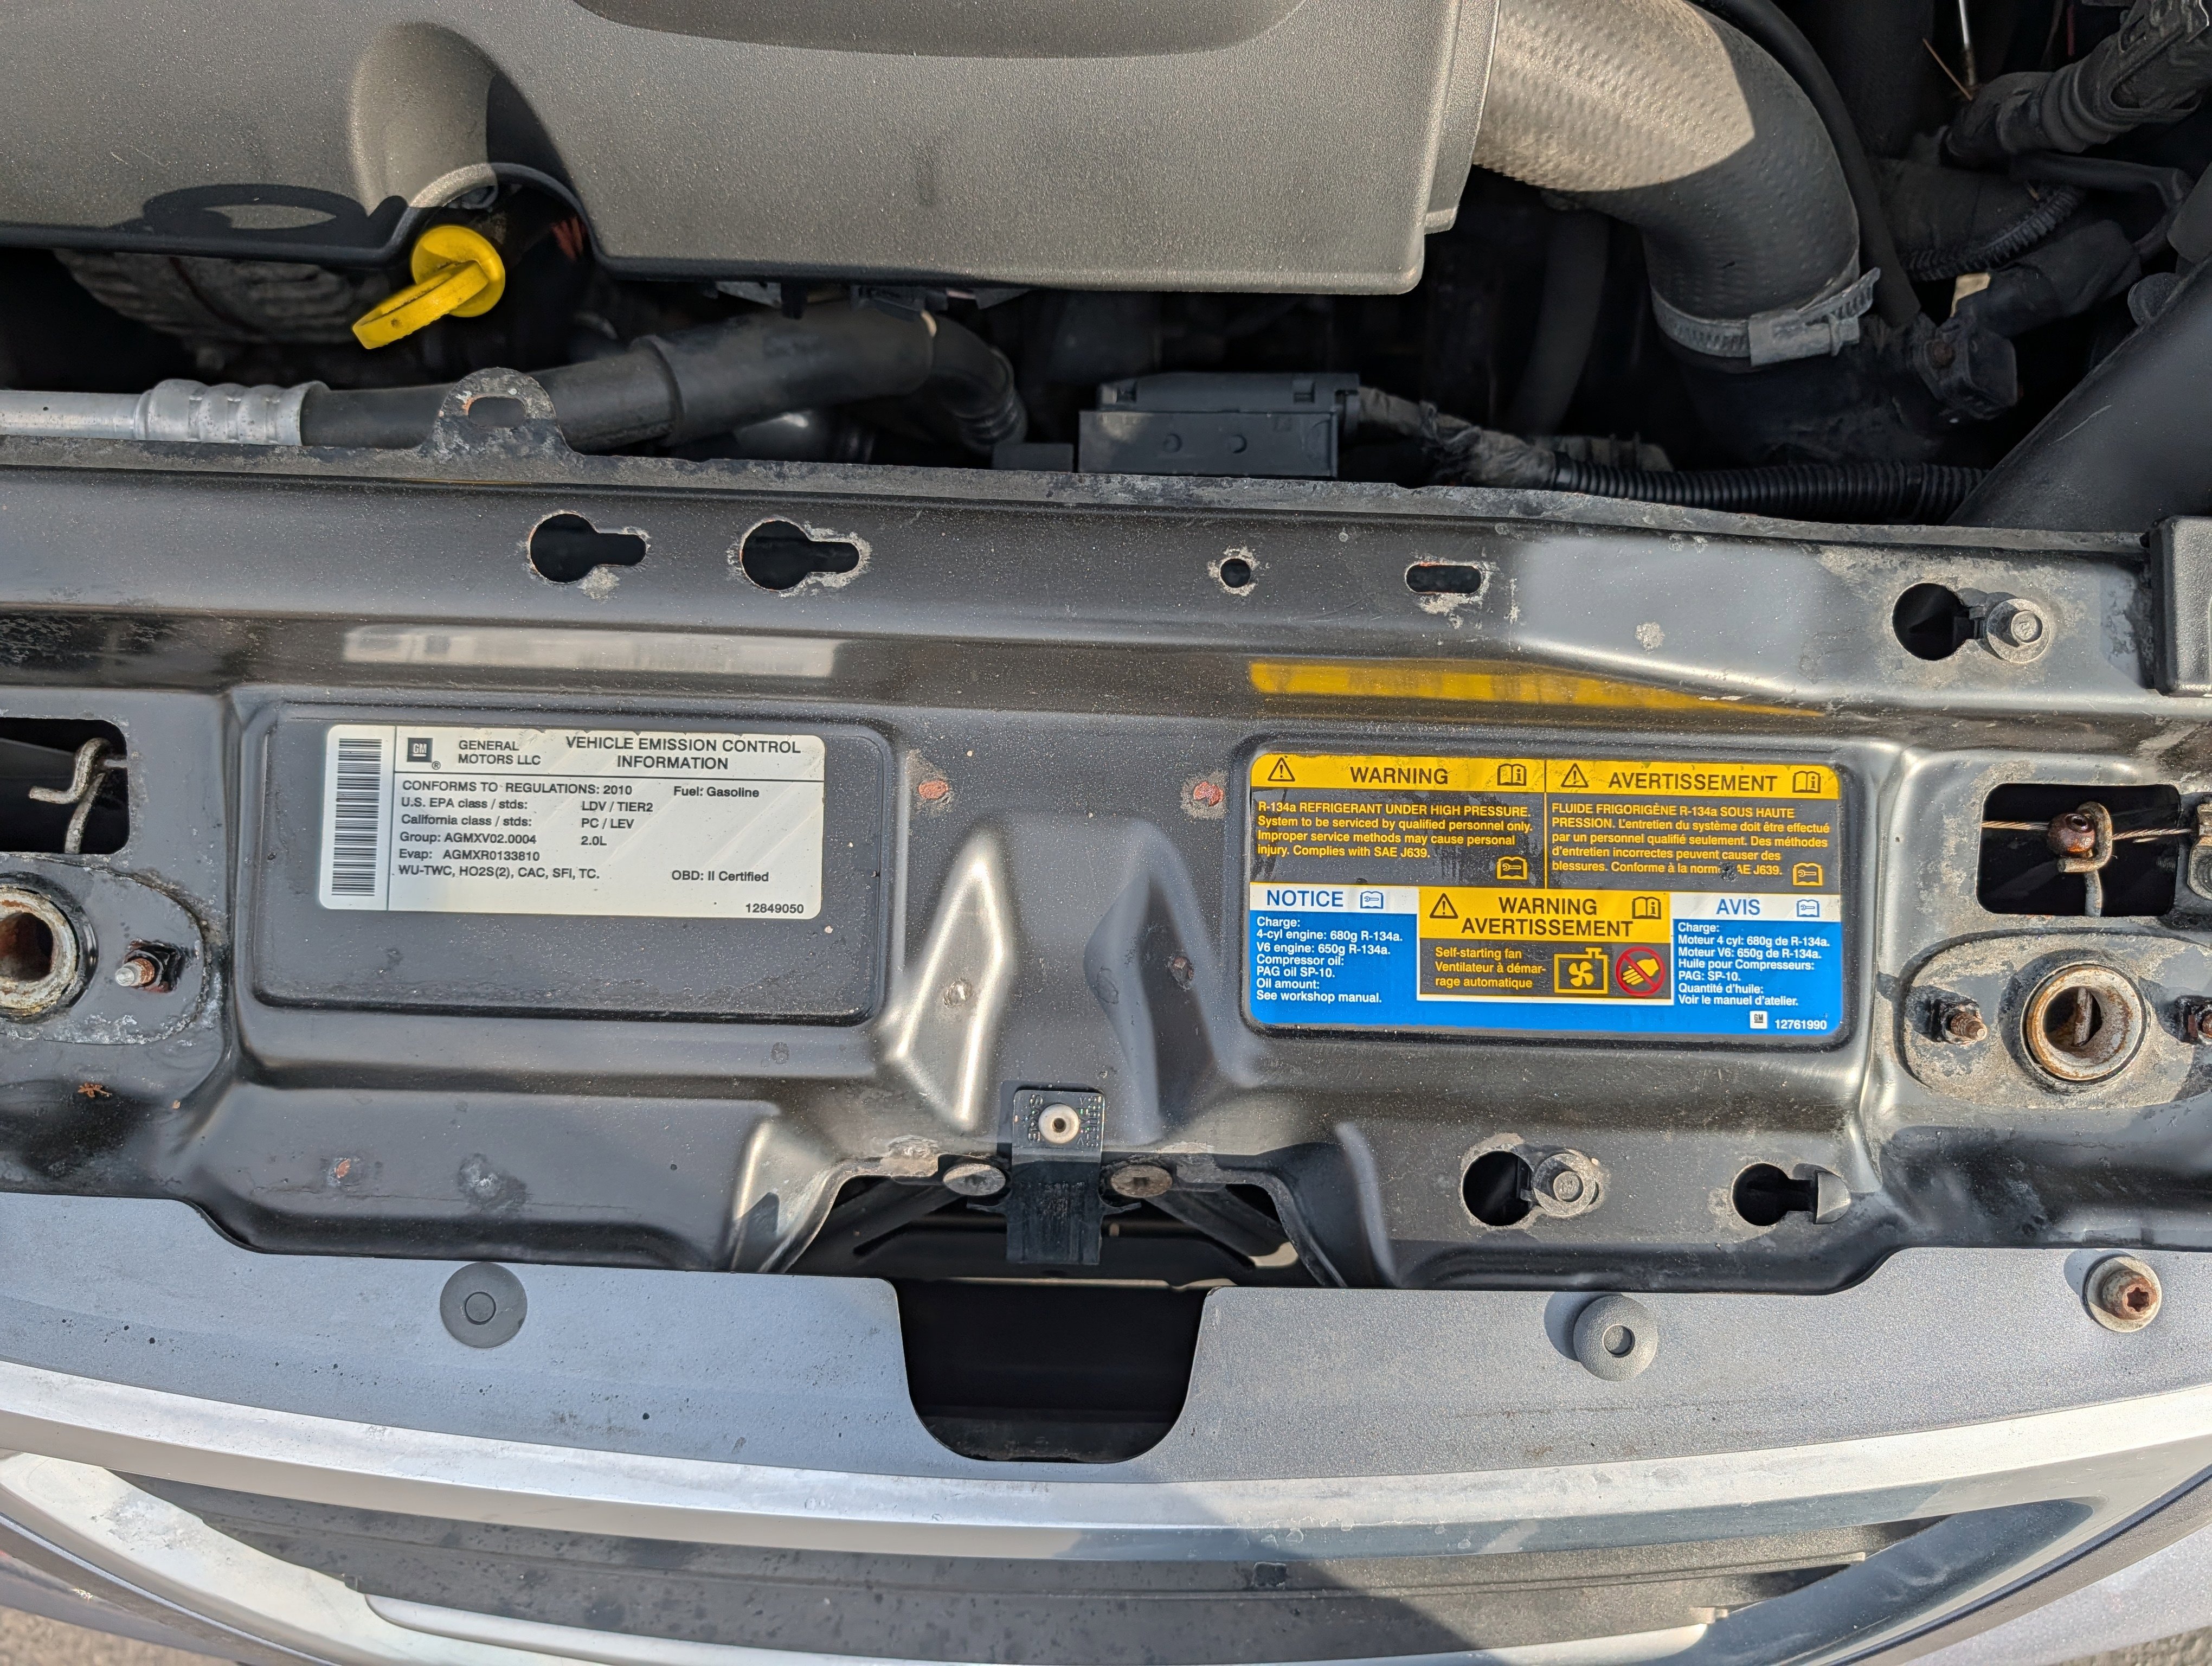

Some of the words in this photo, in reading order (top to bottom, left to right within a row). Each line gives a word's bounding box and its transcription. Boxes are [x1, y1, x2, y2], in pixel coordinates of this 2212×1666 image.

[459, 740, 519, 751] GENERAL
[566, 736, 633, 749] VEHICLE
[639, 738, 717, 751] EMISSION
[723, 740, 801, 753] CONTROL
[459, 754, 513, 764] MOTORS
[517, 755, 541, 765] LLC
[618, 755, 728, 770] INFORMATION
[1350, 767, 1449, 784] WARNING
[1609, 772, 1777, 791] AVERTISSEMENT
[403, 780, 475, 791] CONFORMS
[479, 782, 498, 792] TO
[506, 783, 599, 794] REGULATIONS:
[603, 785, 632, 794] 2010
[674, 786, 703, 796] Fuel:
[707, 787, 759, 797] Gasoline
[402, 797, 425, 807] U.S.
[429, 798, 454, 808] EPA
[458, 799, 487, 808] class
[491, 799, 496, 810] /
[499, 799, 527, 809] stds:
[581, 801, 607, 811] LDV
[609, 802, 614, 812] /
[617, 802, 653, 812] TIER2
[1257, 802, 1297, 814] R-134a
[1300, 802, 1382, 813] REFRIGERANT
[1385, 803, 1427, 815] UNDER
[1431, 805, 1460, 815] HIGH
[1464, 806, 1531, 817] PRESSURE.
[1552, 803, 1593, 814] FLUIDE
[1596, 803, 1676, 815] FRIGORIGÈNE
[1680, 806, 1718, 817] R-134a
[1720, 807, 1753, 817] SOUS
[1756, 808, 1795, 818] HAUTE
[402, 814, 458, 825] California
[461, 816, 491, 825] class
[495, 816, 500, 826] /
[503, 817, 531, 826] stds:
[582, 818, 599, 828] PC
[602, 818, 607, 829] /
[610, 819, 634, 829] LEV
[1258, 815, 1297, 828] System
[1301, 817, 1311, 826] to
[1316, 817, 1329, 826] be
[1333, 818, 1379, 828] serviced
[1382, 818, 1395, 830] by
[1399, 819, 1445, 831] qualified
[1449, 821, 1503, 831] personnel
[1507, 822, 1532, 834] only.
[1552, 817, 1615, 828] PRESSION.
[1676, 820, 1689, 830] du
[1693, 821, 1737, 832] système
[1740, 822, 1760, 831] doit
[1763, 822, 1785, 832] être
[1786, 823, 1830, 833] effectué
[400, 832, 440, 844] Group:
[444, 832, 536, 844] AGMXV02.0004
[581, 836, 607, 845] 2.0L
[1257, 830, 1308, 843] Improper
[1311, 832, 1349, 841] service
[1353, 832, 1401, 843] methods
[1405, 835, 1427, 845] may
[1431, 836, 1463, 844] cause
[1467, 835, 1515, 847] personal
[1552, 834, 1570, 843] par
[1590, 834, 1644, 844] personnel
[1648, 834, 1686, 845] qualifié
[1689, 835, 1747, 845] seulement.
[1750, 836, 1772, 846] Des
[1774, 836, 1828, 847] méthodes
[400, 849, 432, 861] Evap:
[443, 850, 539, 861] AGMXR0133810
[1257, 844, 1289, 857] injury.
[1293, 845, 1345, 857] Complies
[1348, 847, 1370, 856] with
[1374, 847, 1397, 857] SAE
[1400, 847, 1430, 857] J639.
[1552, 846, 1609, 857] d'entretien
[1613, 847, 1673, 858] incorrectes
[1676, 850, 1720, 861] peuvent
[1722, 852, 1758, 860] causer
[1761, 850, 1781, 860] des
[399, 865, 455, 877] WU-TWC,
[460, 866, 513, 879] HO2S(2),
[518, 867, 548, 879] CAC,
[552, 868, 575, 880] SFI,
[579, 869, 599, 879] TC.
[1552, 861, 1607, 871] blessures.
[1611, 862, 1665, 872] Conforme
[1668, 862, 1675, 873] à
[1678, 863, 1687, 873] la
[1689, 865, 1720, 873] norm
[1737, 864, 1751, 874] AE
[1753, 865, 1782, 875] J639.
[672, 870, 703, 880] OBD:
[708, 871, 715, 880] II
[719, 871, 769, 881] Certified
[1268, 890, 1343, 907] NOTICE
[746, 904, 803, 913] 12849050
[1499, 897, 1596, 915] WARNING
[1716, 899, 1760, 915] AVIS
[1257, 917, 1300, 929] Charge:
[1461, 918, 1633, 937] AVERTISSEMENT
[1678, 922, 1719, 934] Charge:
[1257, 929, 1282, 940] 4-cyl
[1286, 930, 1326, 941] engine:
[1330, 931, 1357, 943] 680g
[1361, 931, 1402, 941] R-134a.
[1679, 934, 1715, 944] Moteur
[1717, 935, 1724, 944] 4
[1726, 935, 1744, 947] cyl:
[1747, 936, 1772, 947] 680g
[1775, 937, 1788, 946] de
[1791, 937, 1830, 946] R-134a.
[1257, 942, 1270, 952] V6
[1274, 943, 1314, 954] engine:
[1318, 944, 1345, 956] 650g
[1349, 944, 1390, 954] R-134a.
[1436, 947, 1501, 960] Self-starting
[1504, 949, 1521, 959] fan
[1679, 947, 1715, 957] Moteur
[1718, 947, 1734, 957] V6:
[1737, 948, 1763, 959] 650g
[1766, 949, 1779, 958] de
[1782, 949, 1821, 958] R-134a.
[1257, 966, 1279, 976] PAG
[1284, 967, 1296, 976] oil
[1300, 967, 1335, 977] SP-10.
[1435, 962, 1494, 972] Ventilateur
[1497, 963, 1503, 972] à
[1507, 963, 1546, 973] démar-
[1679, 959, 1705, 968] Huile
[1708, 961, 1733, 970] pour
[1735, 959, 1814, 971] Compresseurs:
[1436, 978, 1460, 988] rage
[1464, 977, 1532, 990] automatique
[1679, 983, 1723, 993] Quantité
[1726, 984, 1763, 994] d'huile:
[1257, 990, 1277, 1000] See
[1281, 991, 1335, 1004] workshop
[1339, 993, 1381, 1002] manual.
[1679, 995, 1699, 1004] Voir
[1702, 995, 1711, 1004] le
[1714, 996, 1752, 1005] manuel
[1755, 996, 1798, 1005] d'atelier.
[1775, 1020, 1827, 1030] 12761990
